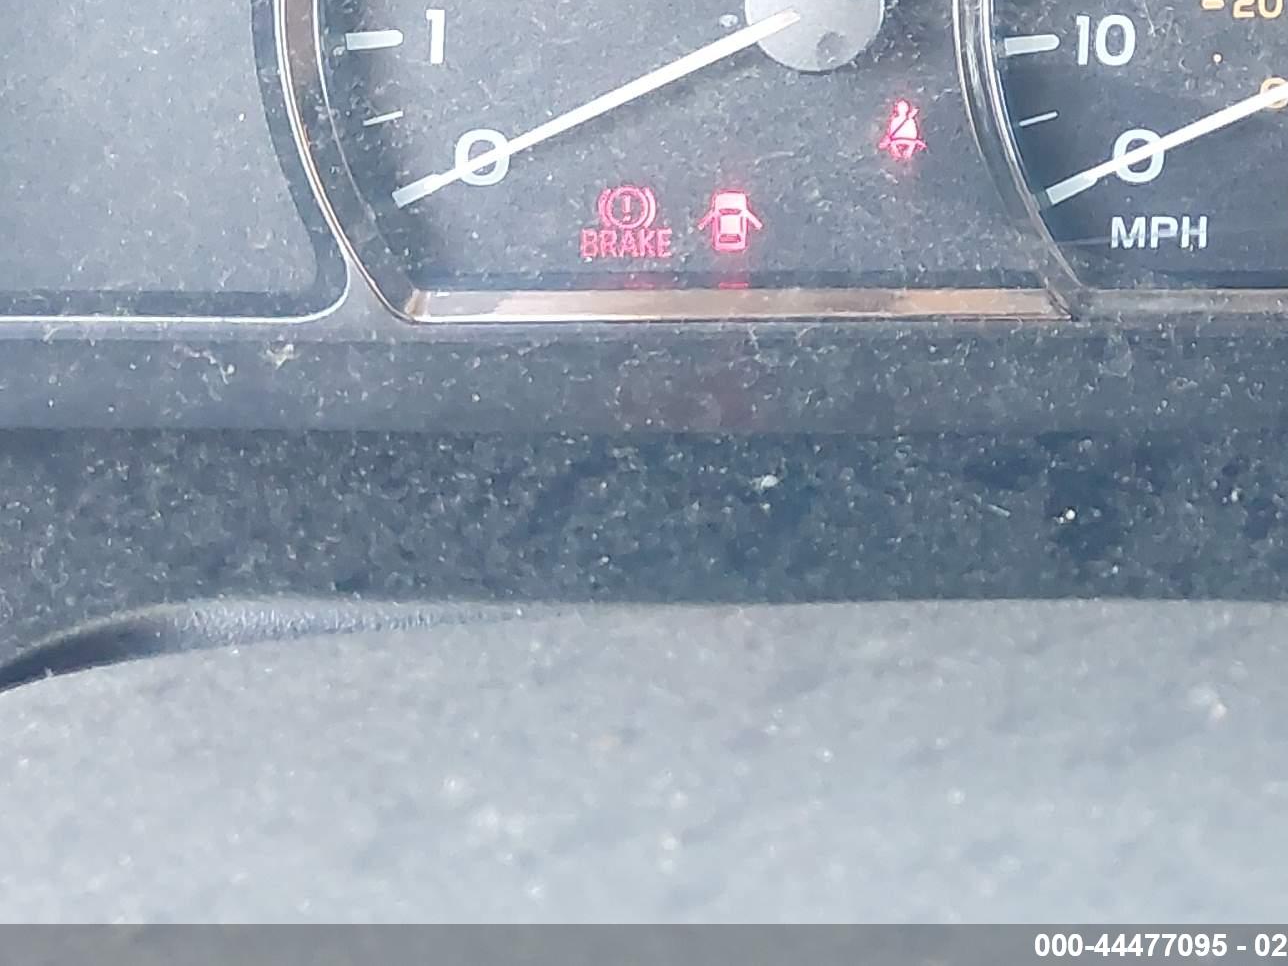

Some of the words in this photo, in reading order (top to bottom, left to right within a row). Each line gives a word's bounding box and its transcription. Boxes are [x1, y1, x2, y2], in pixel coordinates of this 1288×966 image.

[425, 8, 446, 64] 1
[1075, 15, 1135, 66] 10
[454, 128, 511, 186] 0
[1111, 129, 1166, 183] 0
[580, 228, 673, 258] BRAKE
[1110, 216, 1208, 249] MPH
